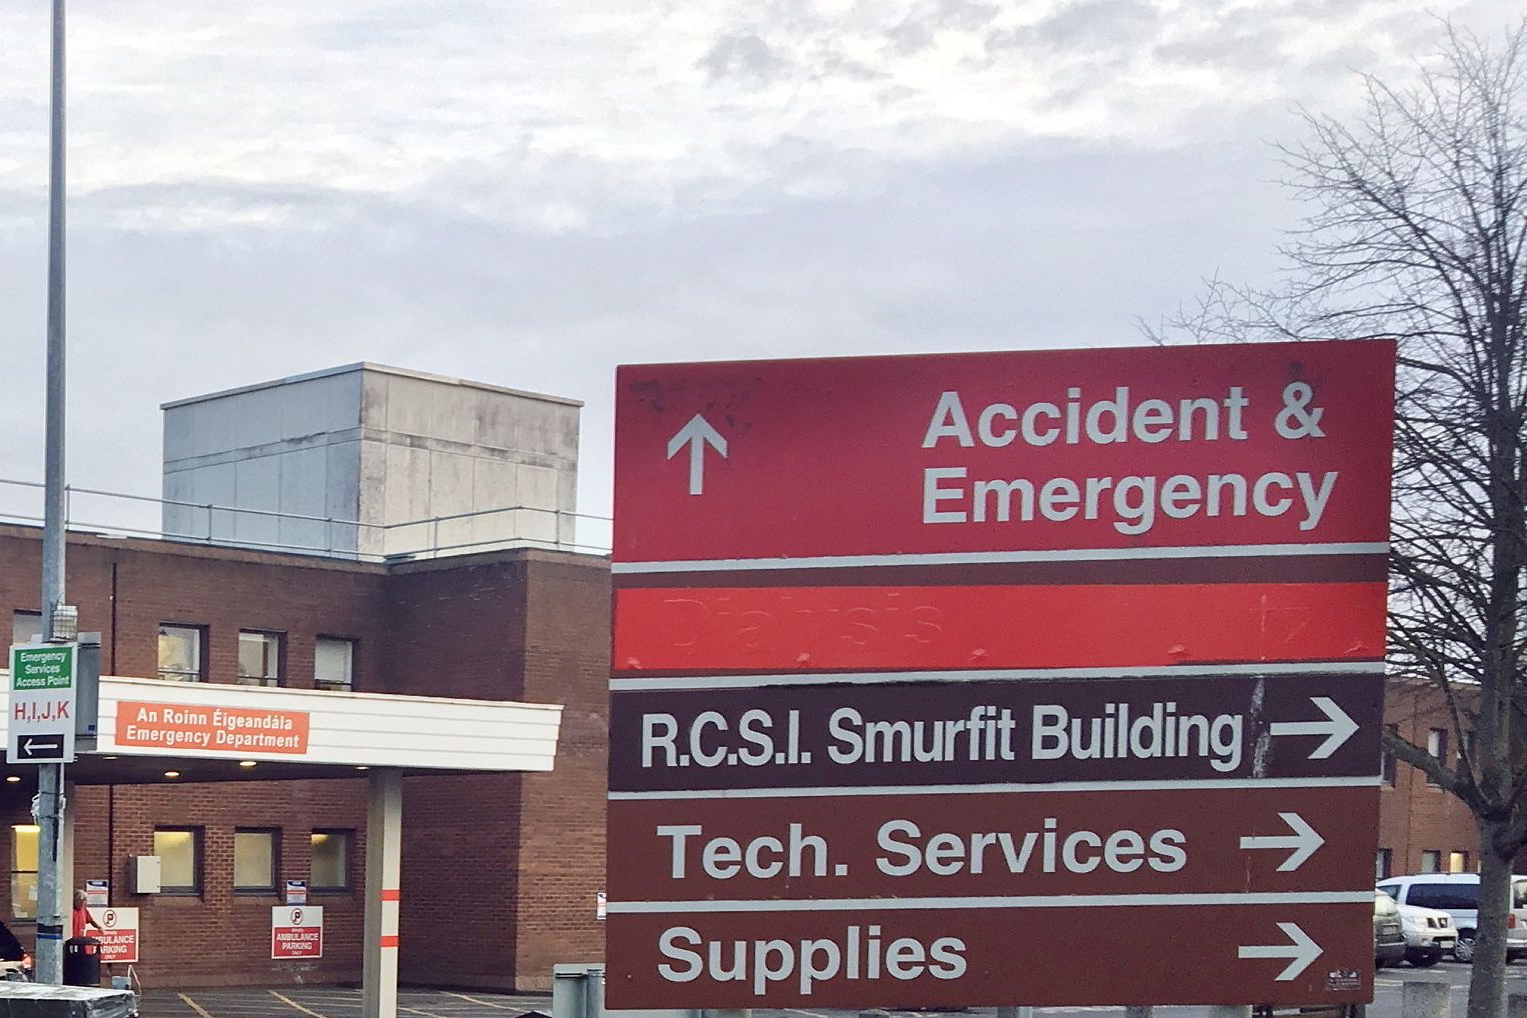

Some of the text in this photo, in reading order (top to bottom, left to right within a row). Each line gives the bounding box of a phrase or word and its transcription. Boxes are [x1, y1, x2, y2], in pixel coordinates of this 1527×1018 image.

[921, 381, 1326, 449] Accident &
[922, 467, 1340, 536] Emergency
[20, 652, 66, 664] Emergency
[25, 664, 61, 675] Services
[16, 675, 70, 687] Access Point
[137, 707, 292, 730] An Roinn Éigeandála
[126, 725, 300, 748] Emergency Department
[641, 702, 1244, 773] R.C.S.I. Smurfit Building
[656, 818, 1188, 879] Tech. Services
[276, 932, 319, 941] AMBULANCE
[281, 941, 313, 951] PARKING
[658, 925, 967, 996] Supplies
